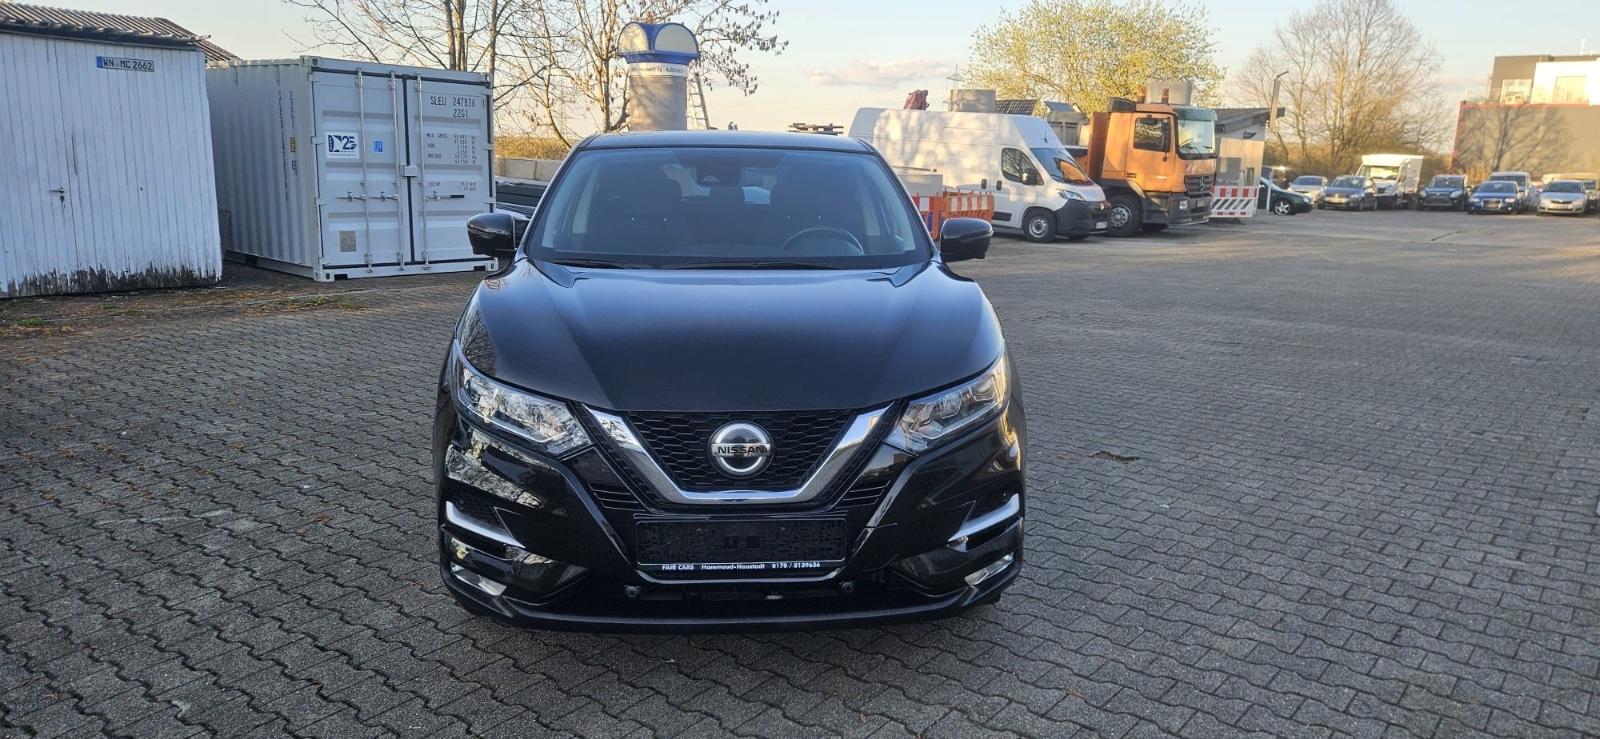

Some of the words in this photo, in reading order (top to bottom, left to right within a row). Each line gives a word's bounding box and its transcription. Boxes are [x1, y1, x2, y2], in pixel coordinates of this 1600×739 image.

[103, 58, 114, 67] WN
[120, 59, 131, 69] MC
[133, 61, 153, 71] 2662
[430, 96, 447, 106] SLEU
[717, 446, 765, 454] NISSAN
